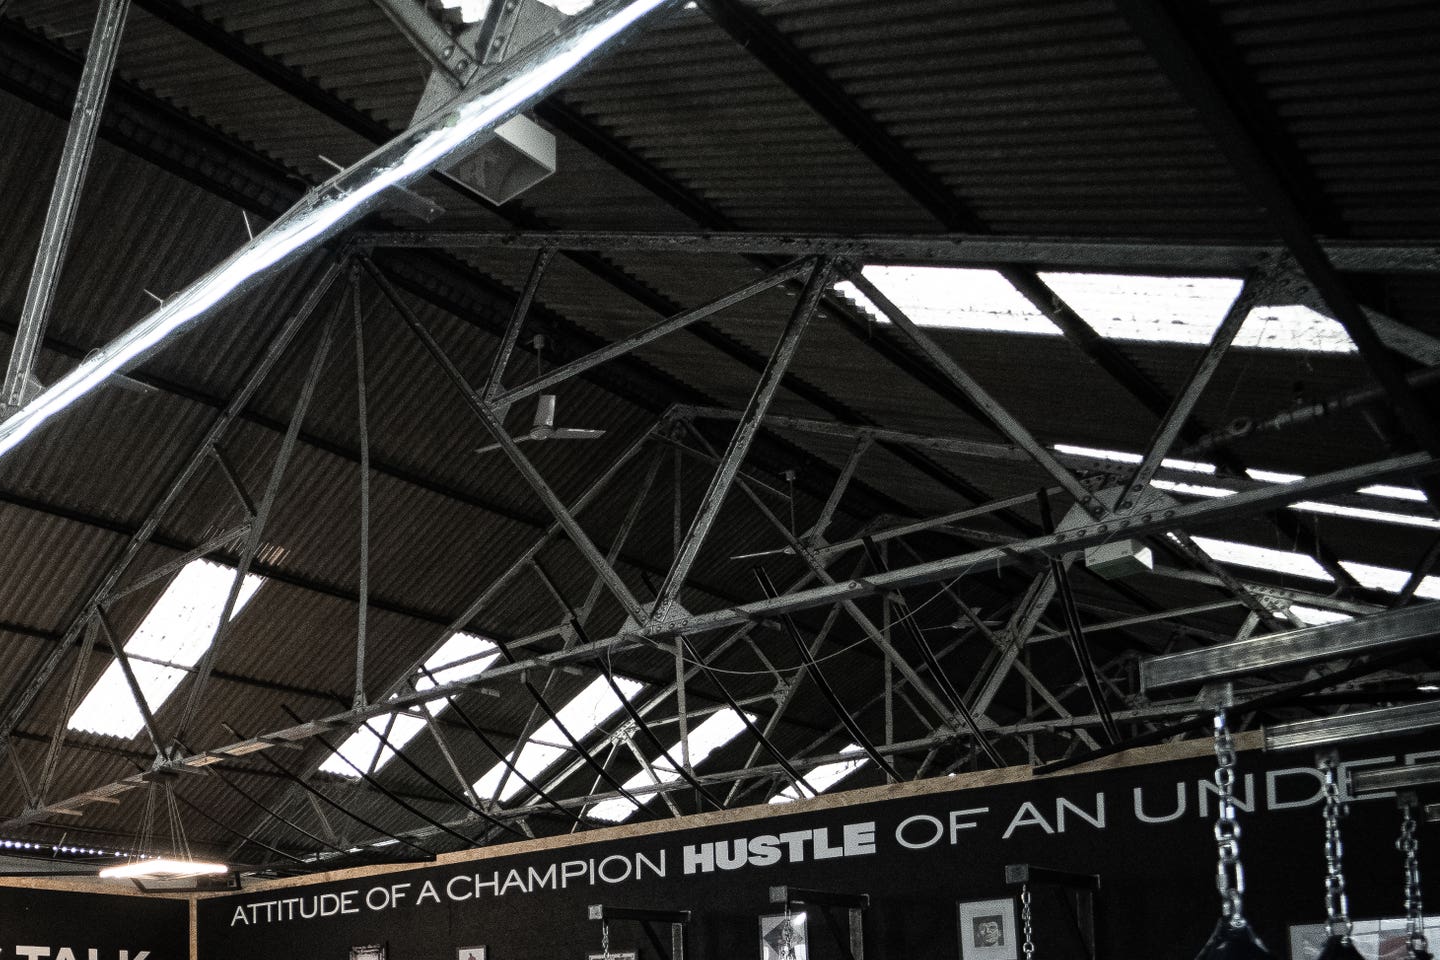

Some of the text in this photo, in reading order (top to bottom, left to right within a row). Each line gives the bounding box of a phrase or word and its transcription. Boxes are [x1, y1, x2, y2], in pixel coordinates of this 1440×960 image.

[230, 750, 1440, 927] ATTITUDE OF A CHAMPION HUSTLE OF AN UNDE
